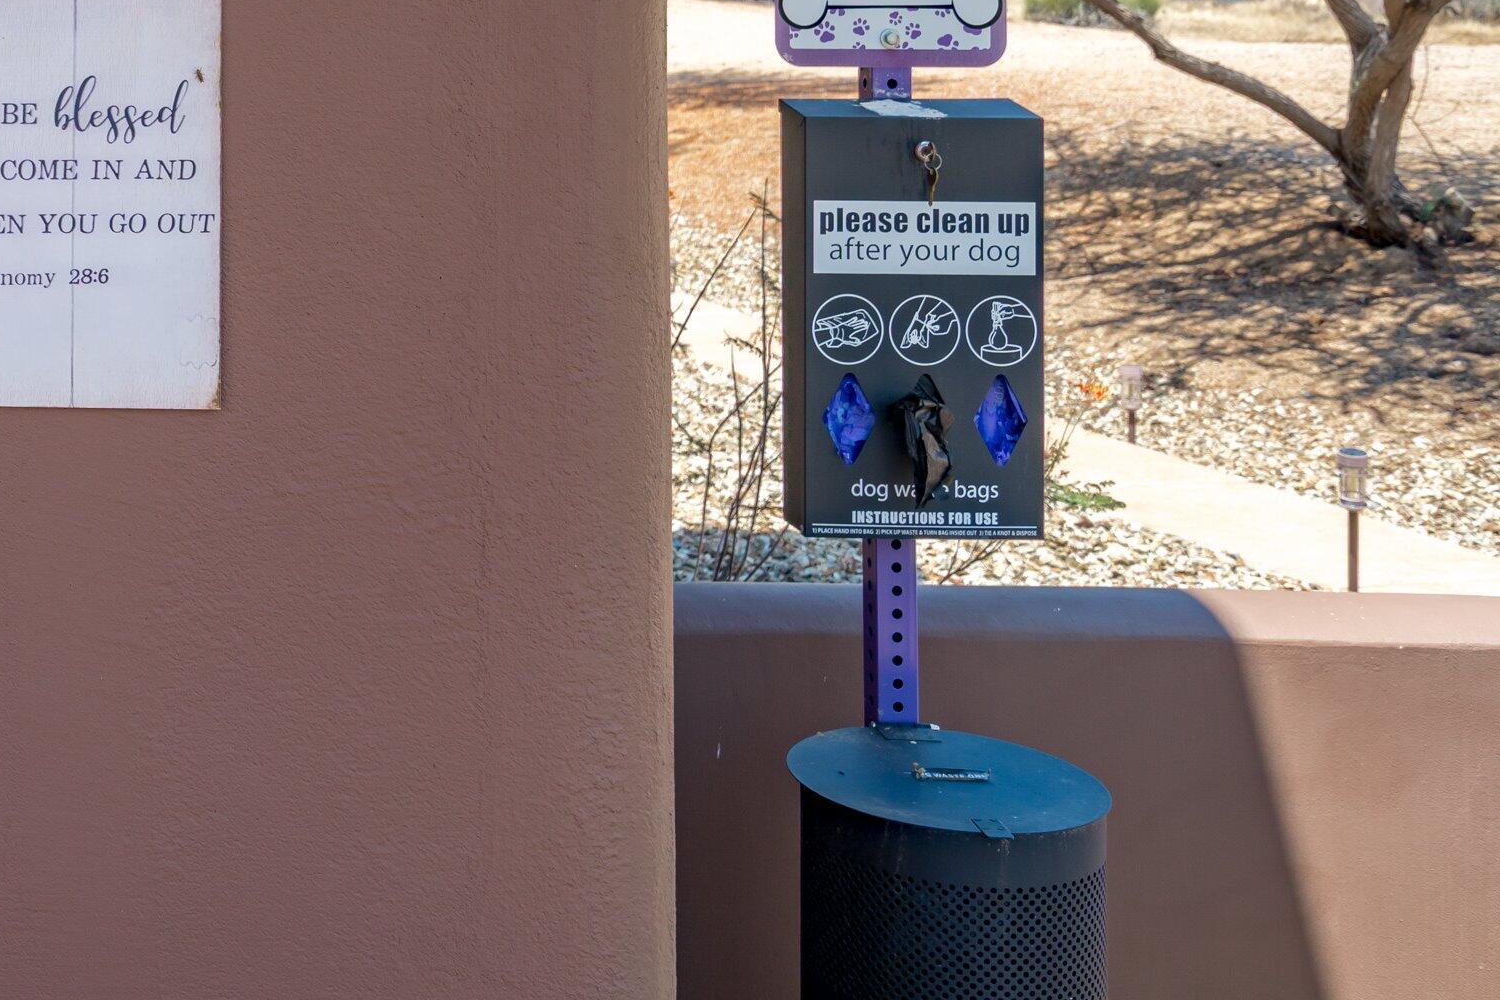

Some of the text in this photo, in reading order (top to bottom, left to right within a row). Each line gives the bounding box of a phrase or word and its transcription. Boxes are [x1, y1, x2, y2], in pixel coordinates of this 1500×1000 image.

[0, 102, 38, 126] BE
[53, 74, 189, 145] blessed
[0, 158, 79, 182] COME
[89, 159, 123, 181] IN
[133, 158, 198, 181] AND
[37, 213, 99, 235] YOU
[108, 212, 147, 235] GO
[156, 212, 216, 235] OUT
[819, 207, 1030, 237] please clean up
[829, 236, 1020, 268] after your dog
[67, 267, 110, 285] 28:6
[851, 478, 889, 502] dog
[954, 479, 999, 503] bags
[851, 510, 999, 526] INSTRUCTIONS FOR USE
